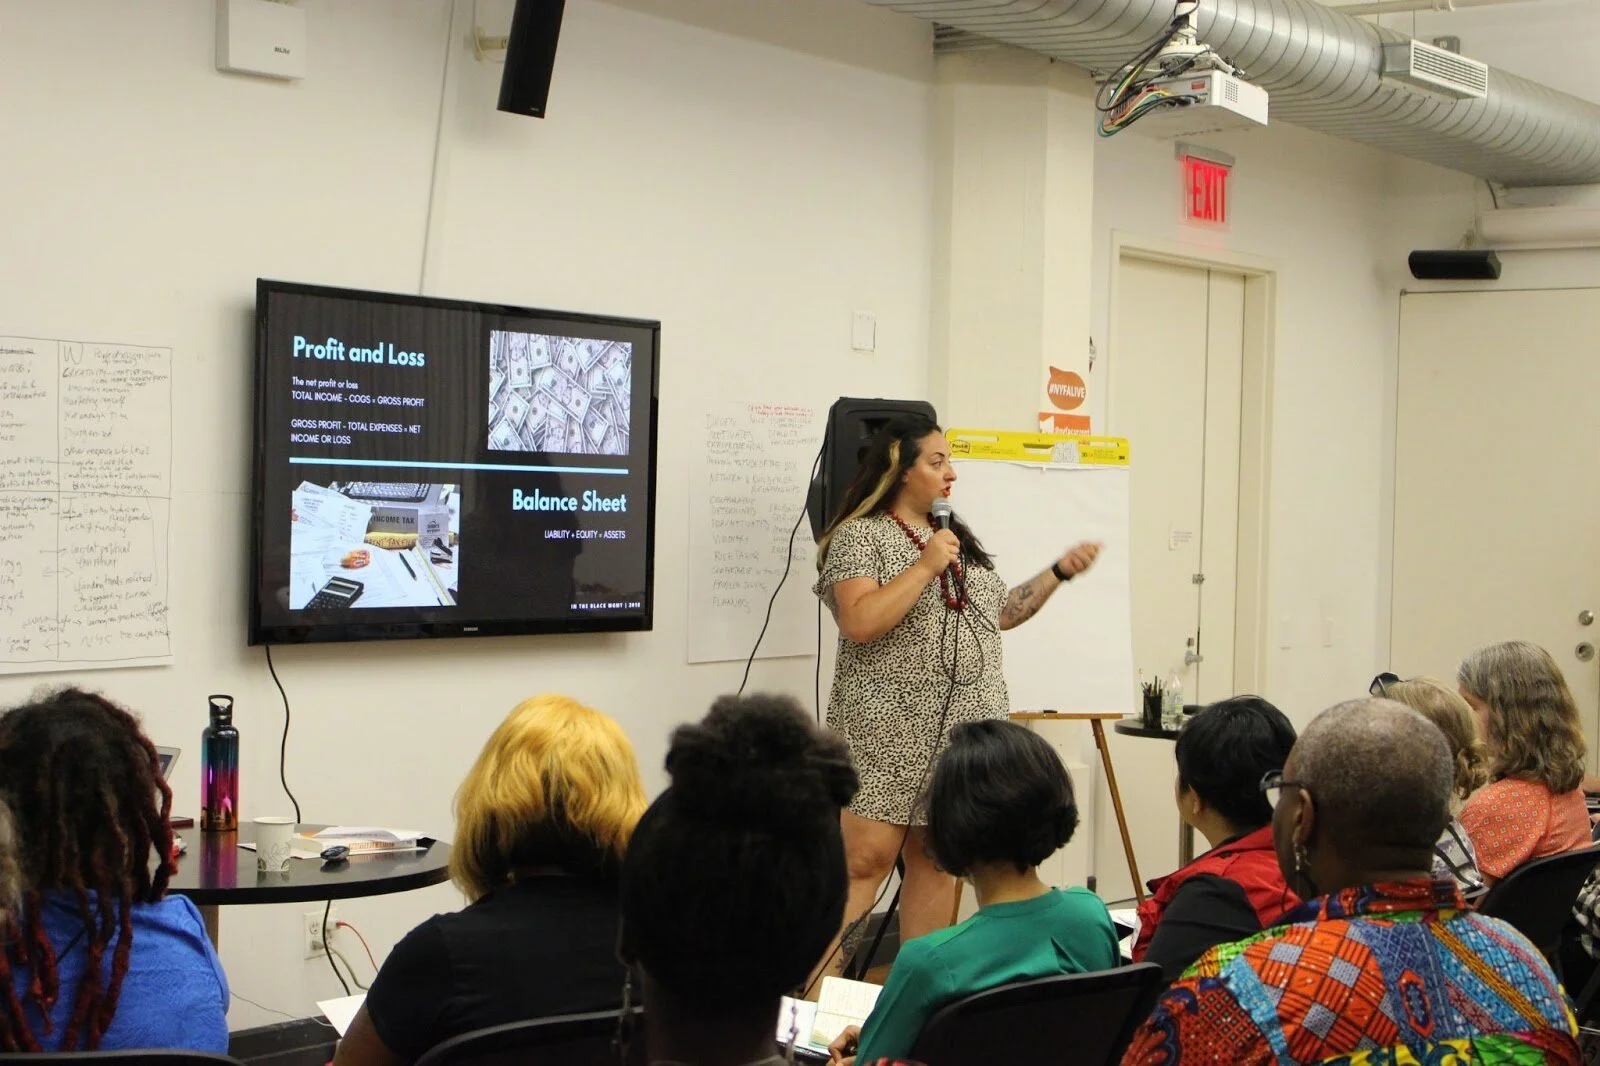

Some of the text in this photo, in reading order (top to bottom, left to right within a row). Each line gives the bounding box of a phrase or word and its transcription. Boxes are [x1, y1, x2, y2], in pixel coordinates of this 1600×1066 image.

[1192, 161, 1228, 222] EXIT
[293, 336, 425, 366] Profit and Loss
[292, 376, 304, 386] The
[318, 378, 336, 389] profit
[346, 380, 358, 389] loss
[292, 390, 312, 400] TOTAL
[314, 392, 342, 402] INCOME
[348, 394, 371, 404] COGS
[377, 396, 402, 406] GROSS
[403, 397, 424, 406] PROFIT
[291, 419, 317, 429] GROSS
[318, 420, 341, 430] PROFIT
[348, 421, 368, 432] TOTAL
[370, 423, 403, 433] EXPENSES
[409, 424, 421, 433] NET
[291, 434, 351, 445] INCOME OR LOSS
[512, 488, 627, 512] Balance Sheet
[544, 530, 570, 539] LIABILITY
[576, 530, 598, 539] EQUITY
[604, 530, 626, 539] ASSETS
